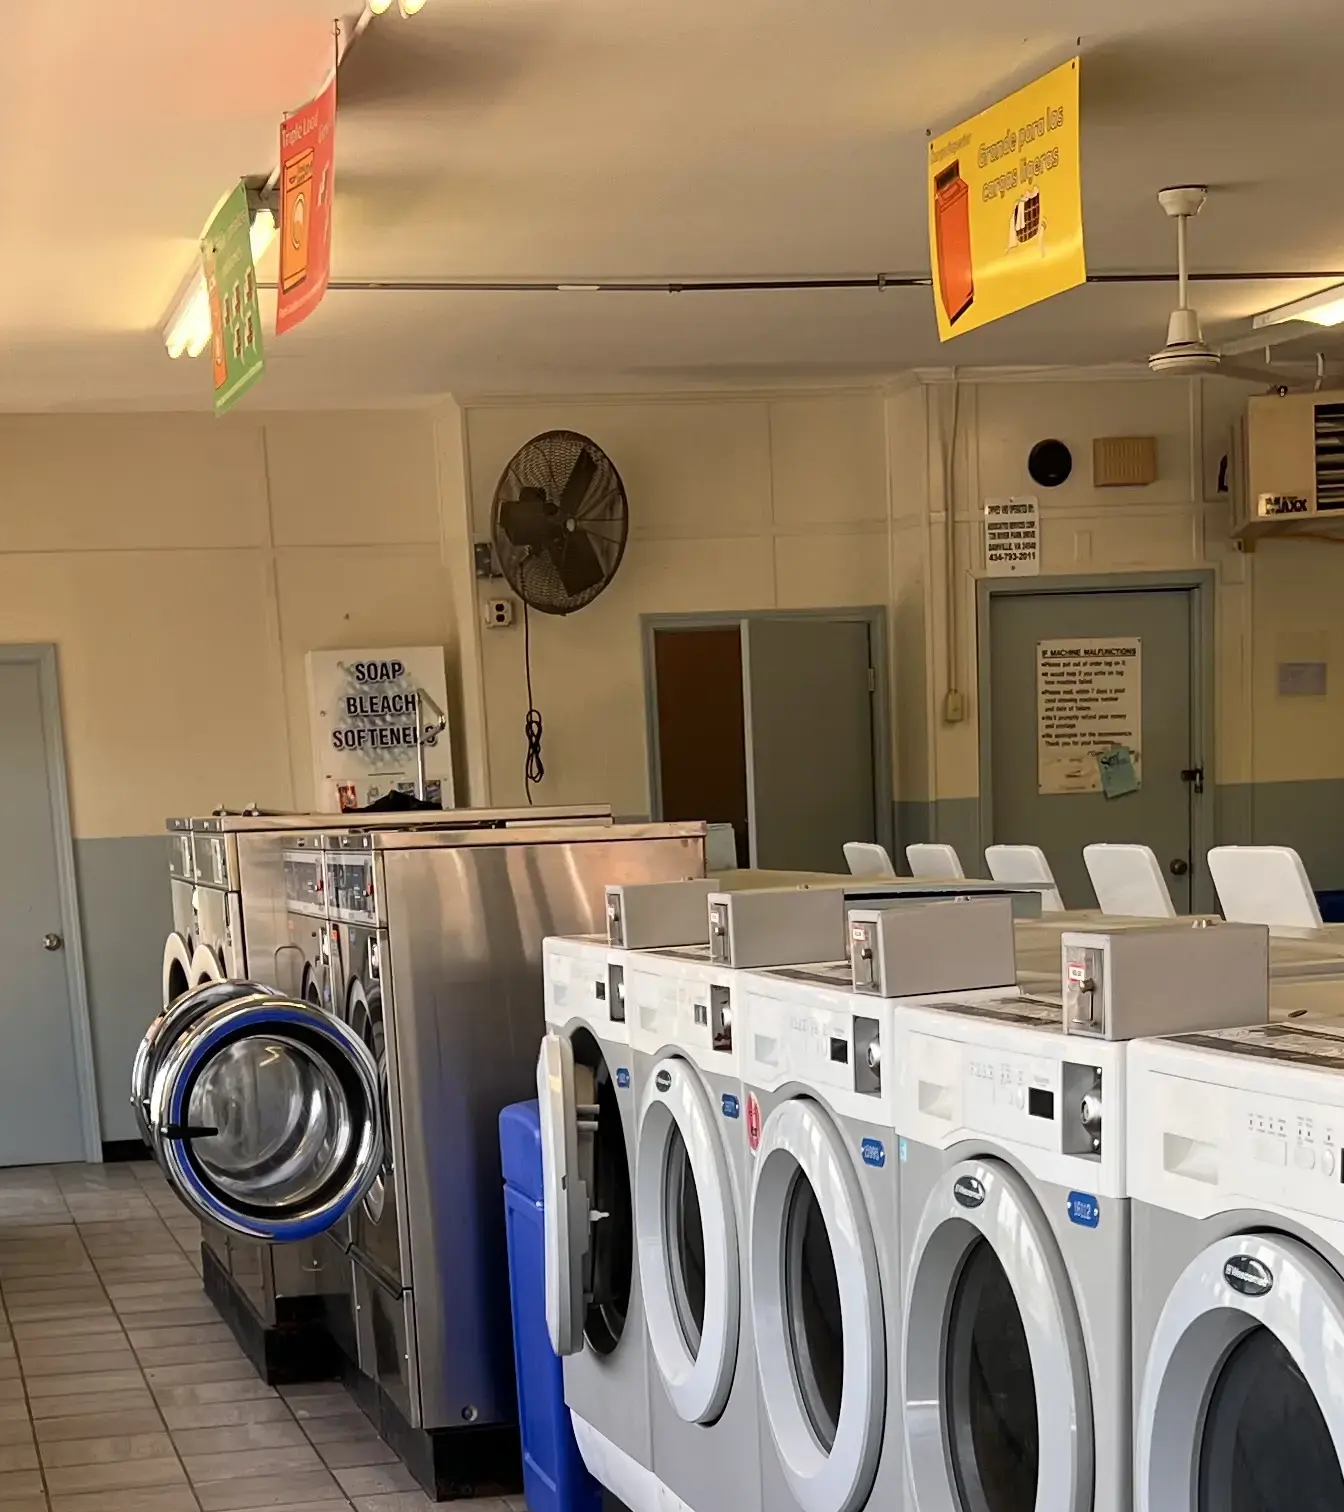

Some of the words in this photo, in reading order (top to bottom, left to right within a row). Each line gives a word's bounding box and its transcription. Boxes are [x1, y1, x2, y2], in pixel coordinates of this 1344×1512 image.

[978, 129, 1017, 168] Grande
[1018, 117, 1044, 153] para
[983, 168, 1017, 202] cargas
[1020, 147, 1058, 184] ligeras
[1084, 648, 1136, 656] MALFUNCTIONS
[355, 661, 405, 682] SOAP
[346, 694, 416, 716] BLEACH
